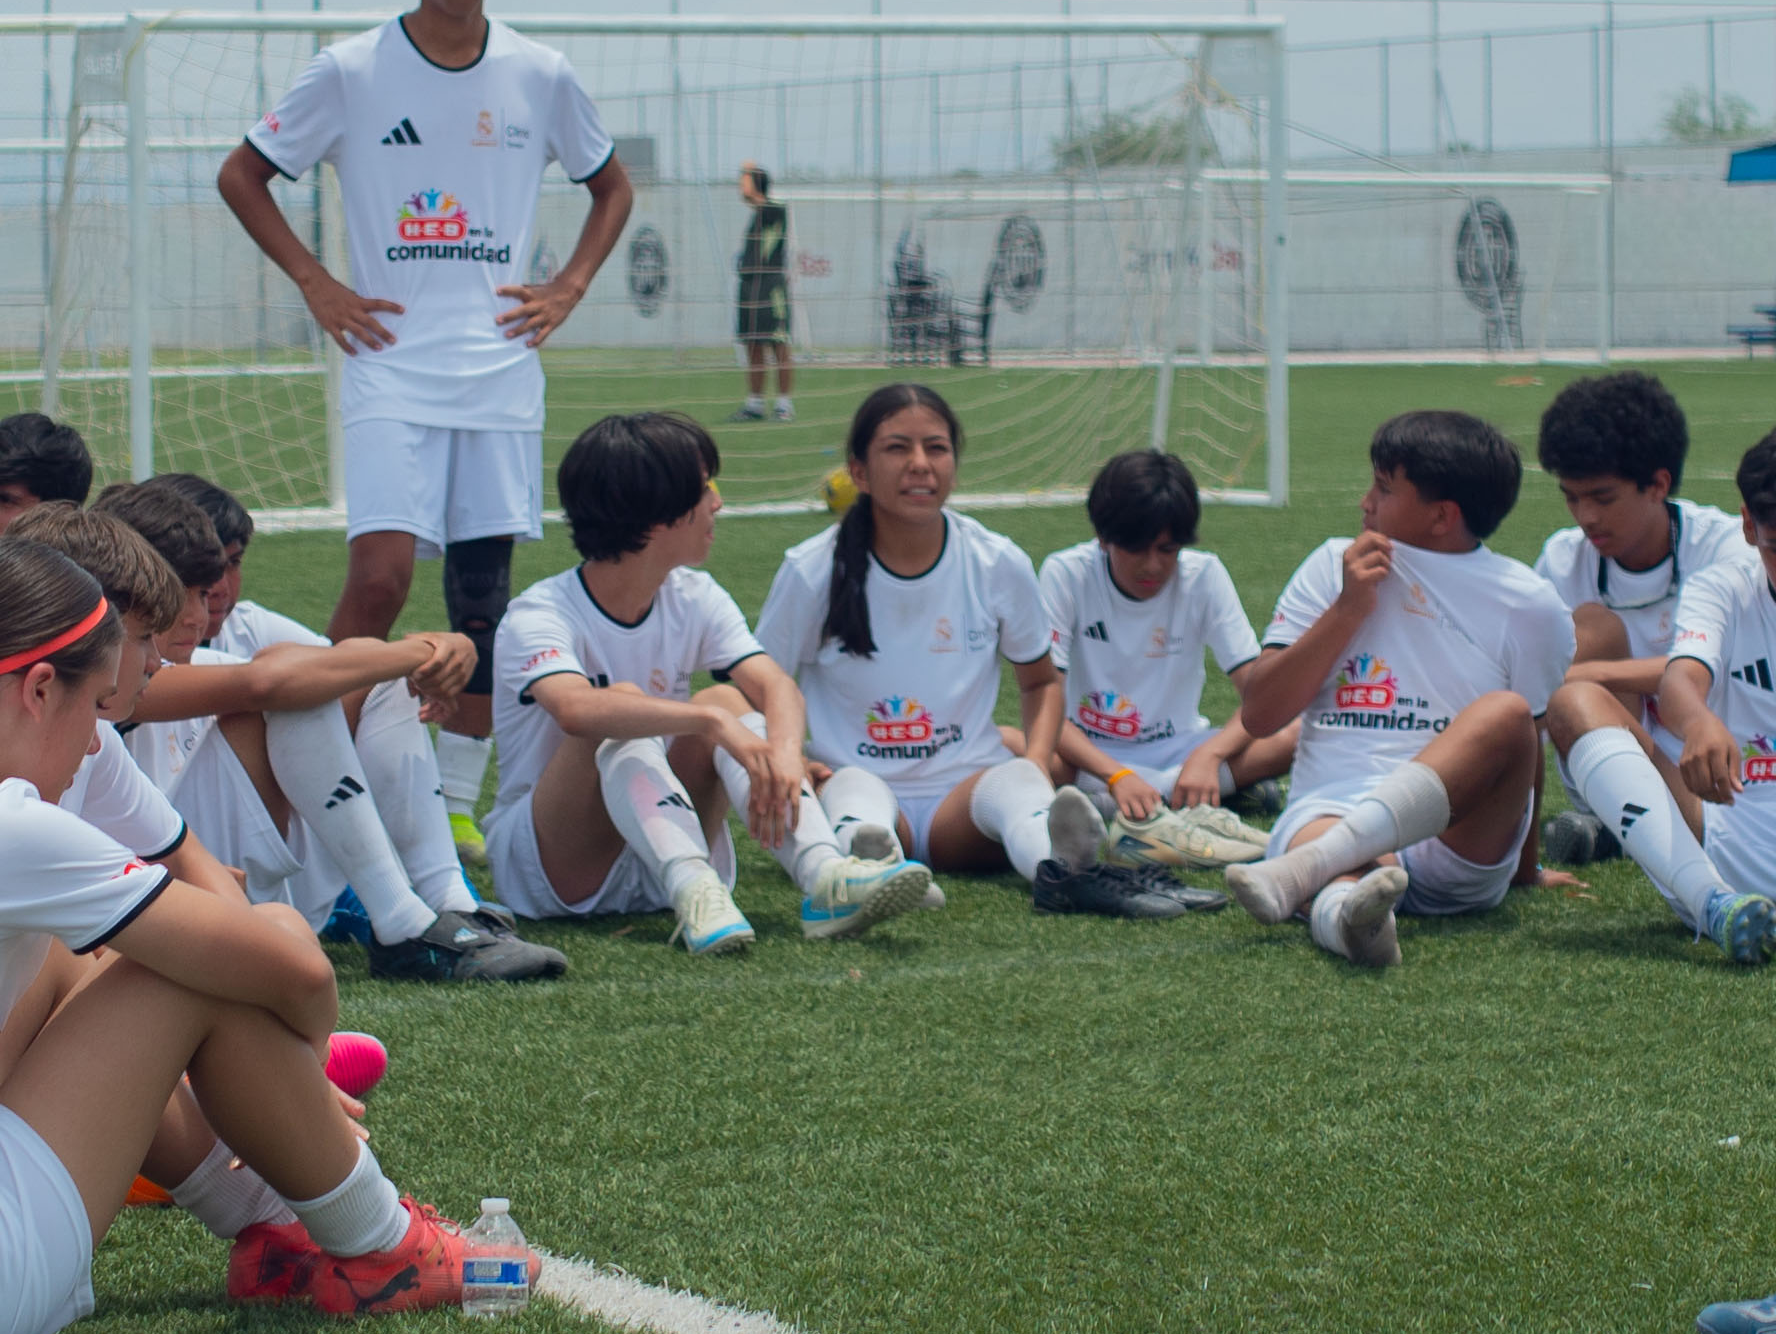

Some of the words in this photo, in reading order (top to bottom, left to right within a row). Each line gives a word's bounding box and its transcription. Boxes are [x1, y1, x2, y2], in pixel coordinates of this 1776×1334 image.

[387, 240, 511, 263] comunidad
[1397, 696, 1413, 707] en
[1417, 696, 1429, 709] la
